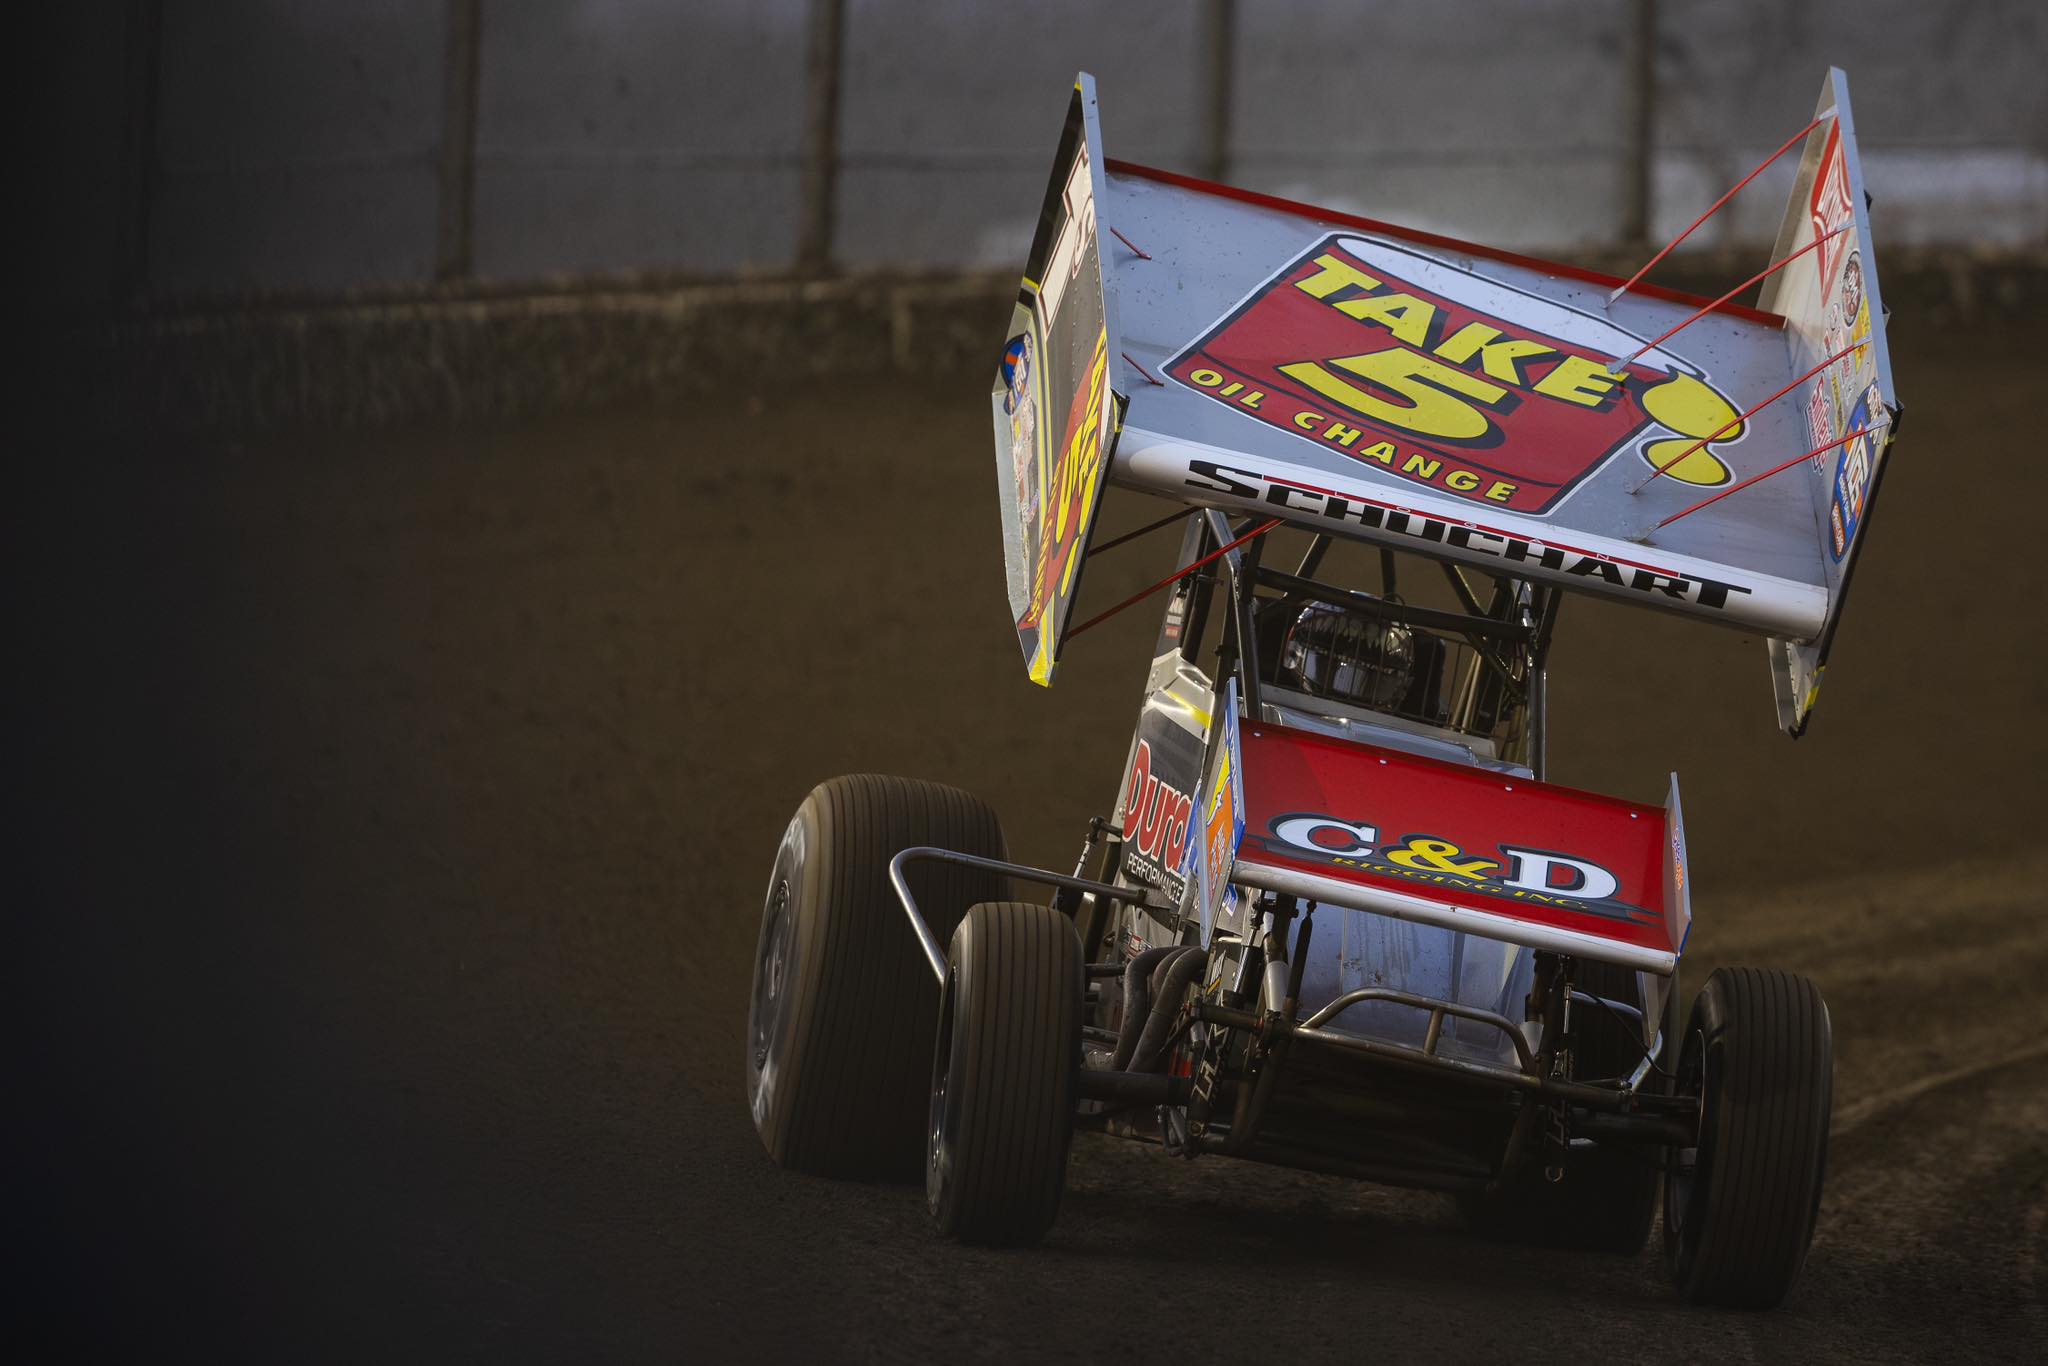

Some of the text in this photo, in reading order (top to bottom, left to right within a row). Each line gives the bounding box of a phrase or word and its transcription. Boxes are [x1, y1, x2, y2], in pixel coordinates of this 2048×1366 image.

[1294, 253, 1628, 408] TAKE
[1189, 368, 1519, 504] OIL CHANGE
[1276, 347, 1508, 440] 5
[1184, 459, 1752, 610] SCHUCHART
[1275, 817, 1618, 900] C&D
[1331, 857, 1503, 893] RIGGING
